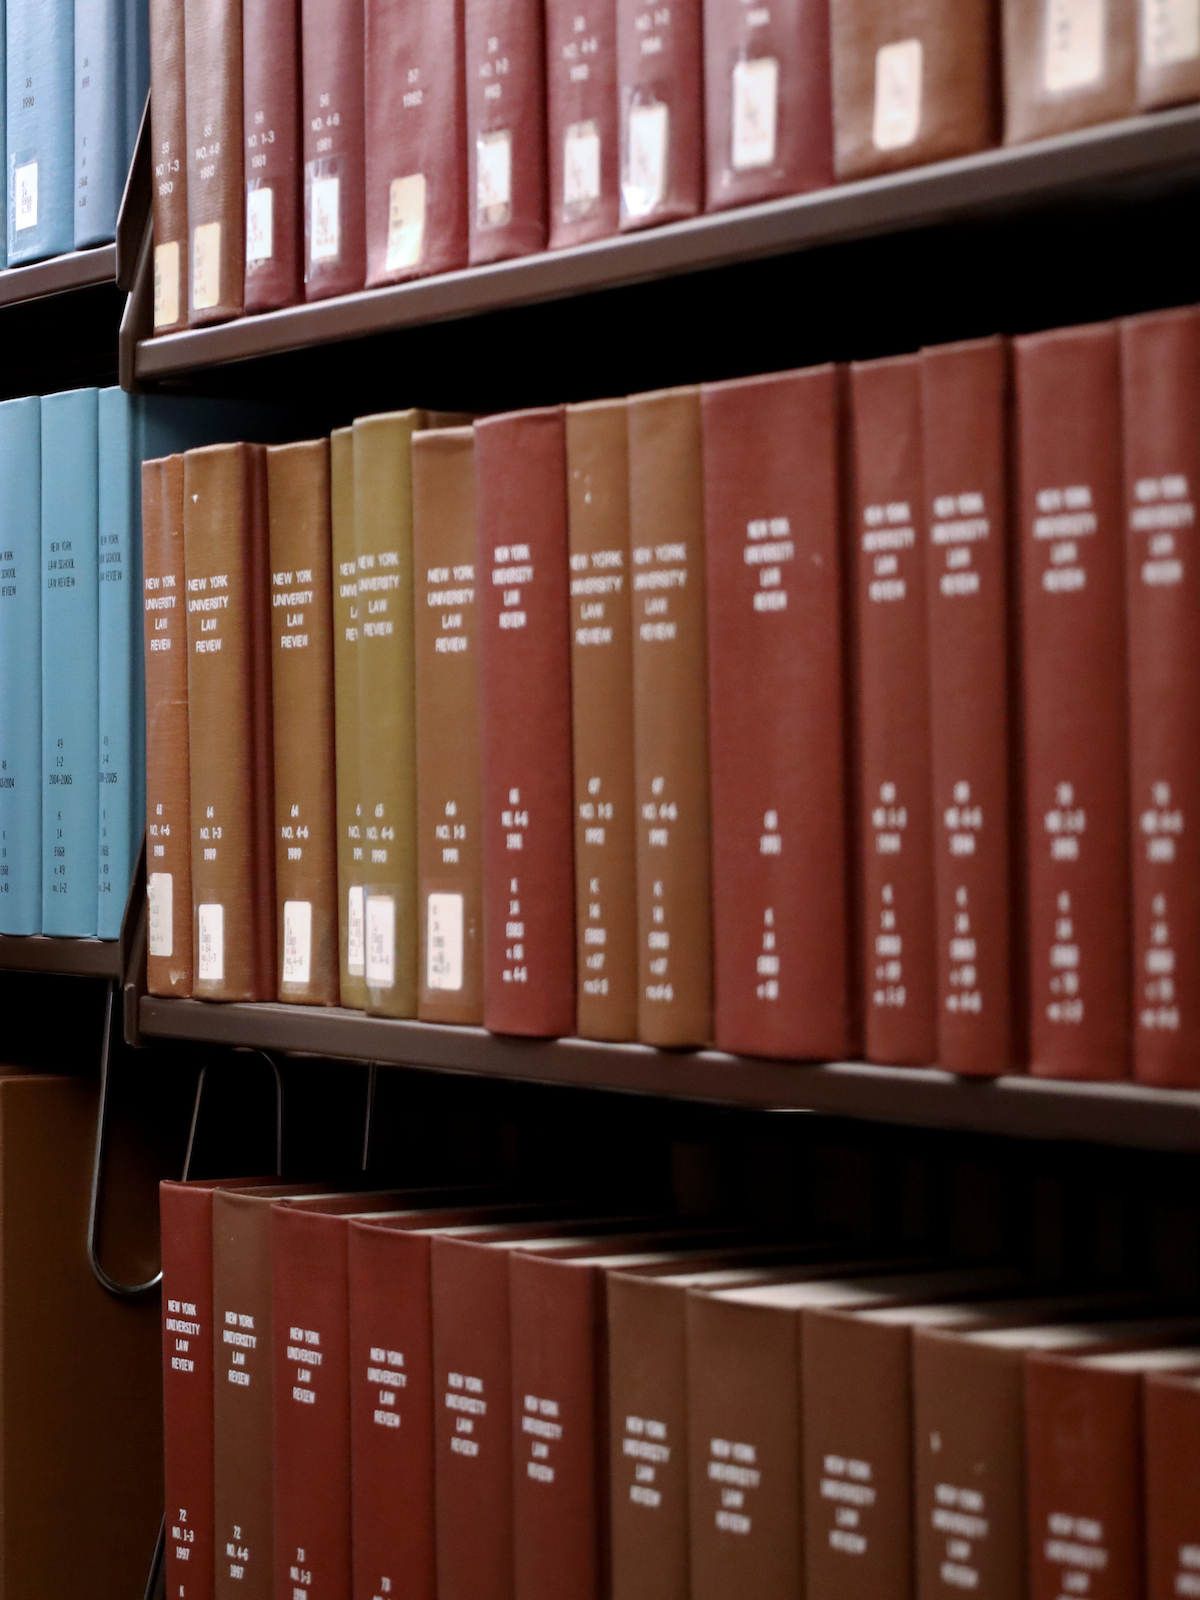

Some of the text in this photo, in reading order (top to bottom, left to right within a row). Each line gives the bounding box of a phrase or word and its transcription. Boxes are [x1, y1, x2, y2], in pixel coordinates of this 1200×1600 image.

[168, 160, 179, 172] 1-3
[61, 541, 72, 551] YORK
[48, 558, 75, 570] LAW SCHOOL
[358, 552, 398, 569] NEW YORK
[146, 575, 176, 589] NEW YORK
[273, 569, 312, 585] NEW YORK
[428, 566, 474, 583] NEW YORK
[48, 577, 75, 588] LAW REVIEW
[188, 575, 227, 591] NEW YORK
[358, 575, 399, 591] UNIVERSITY
[146, 596, 176, 610] UNIVERSITY
[189, 596, 228, 612] UNIVERSITY
[273, 591, 313, 607] UNIVERSITY
[428, 589, 475, 606] UNIVERSITY
[369, 599, 387, 614] LAW
[155, 618, 167, 630] LAW
[201, 618, 216, 631] LAW
[287, 613, 304, 626] LAW
[442, 613, 462, 629] LAW
[364, 622, 393, 636] REVIEW
[151, 638, 171, 650] REVIEW
[196, 638, 222, 652] REVIEW
[281, 634, 308, 648] REVIEW
[435, 636, 467, 652] REVIEW
[49, 774, 72, 785] 2004-2005
[57, 829, 62, 838] 14
[150, 824, 170, 836] NO. 4-6
[200, 827, 222, 839] NO. 1-3
[282, 826, 309, 839] NO. 4-6
[204, 848, 216, 860] 1989
[288, 847, 302, 860] 1989
[59, 864, 65, 874] 49
[59, 883, 67, 893] 1-2
[168, 1300, 196, 1316] NEW YORK
[166, 1318, 200, 1335] UNIVERSITY
[225, 1311, 254, 1329] NEW YORK
[223, 1329, 256, 1348] UNIVERSITY
[289, 1327, 320, 1345] NEW YORK
[176, 1338, 189, 1352] LAW
[232, 1351, 245, 1365] LAW
[287, 1346, 322, 1365] UNIVERSITY
[370, 1347, 404, 1367] NEW YORK
[171, 1357, 194, 1372] REVIEW
[228, 1369, 250, 1386] REVIEW
[297, 1368, 311, 1383] LAW
[367, 1367, 407, 1388] UNIVERSITY
[293, 1387, 315, 1404] REVIEW
[379, 1390, 395, 1405] LAW
[374, 1410, 400, 1428] REVIEW
[172, 1526, 194, 1542] NO. 1-3
[176, 1546, 190, 1560] 1997
[226, 1543, 248, 1561] NO. 4-6
[230, 1564, 244, 1579] 1997
[290, 1566, 311, 1585] NO. 1-3
